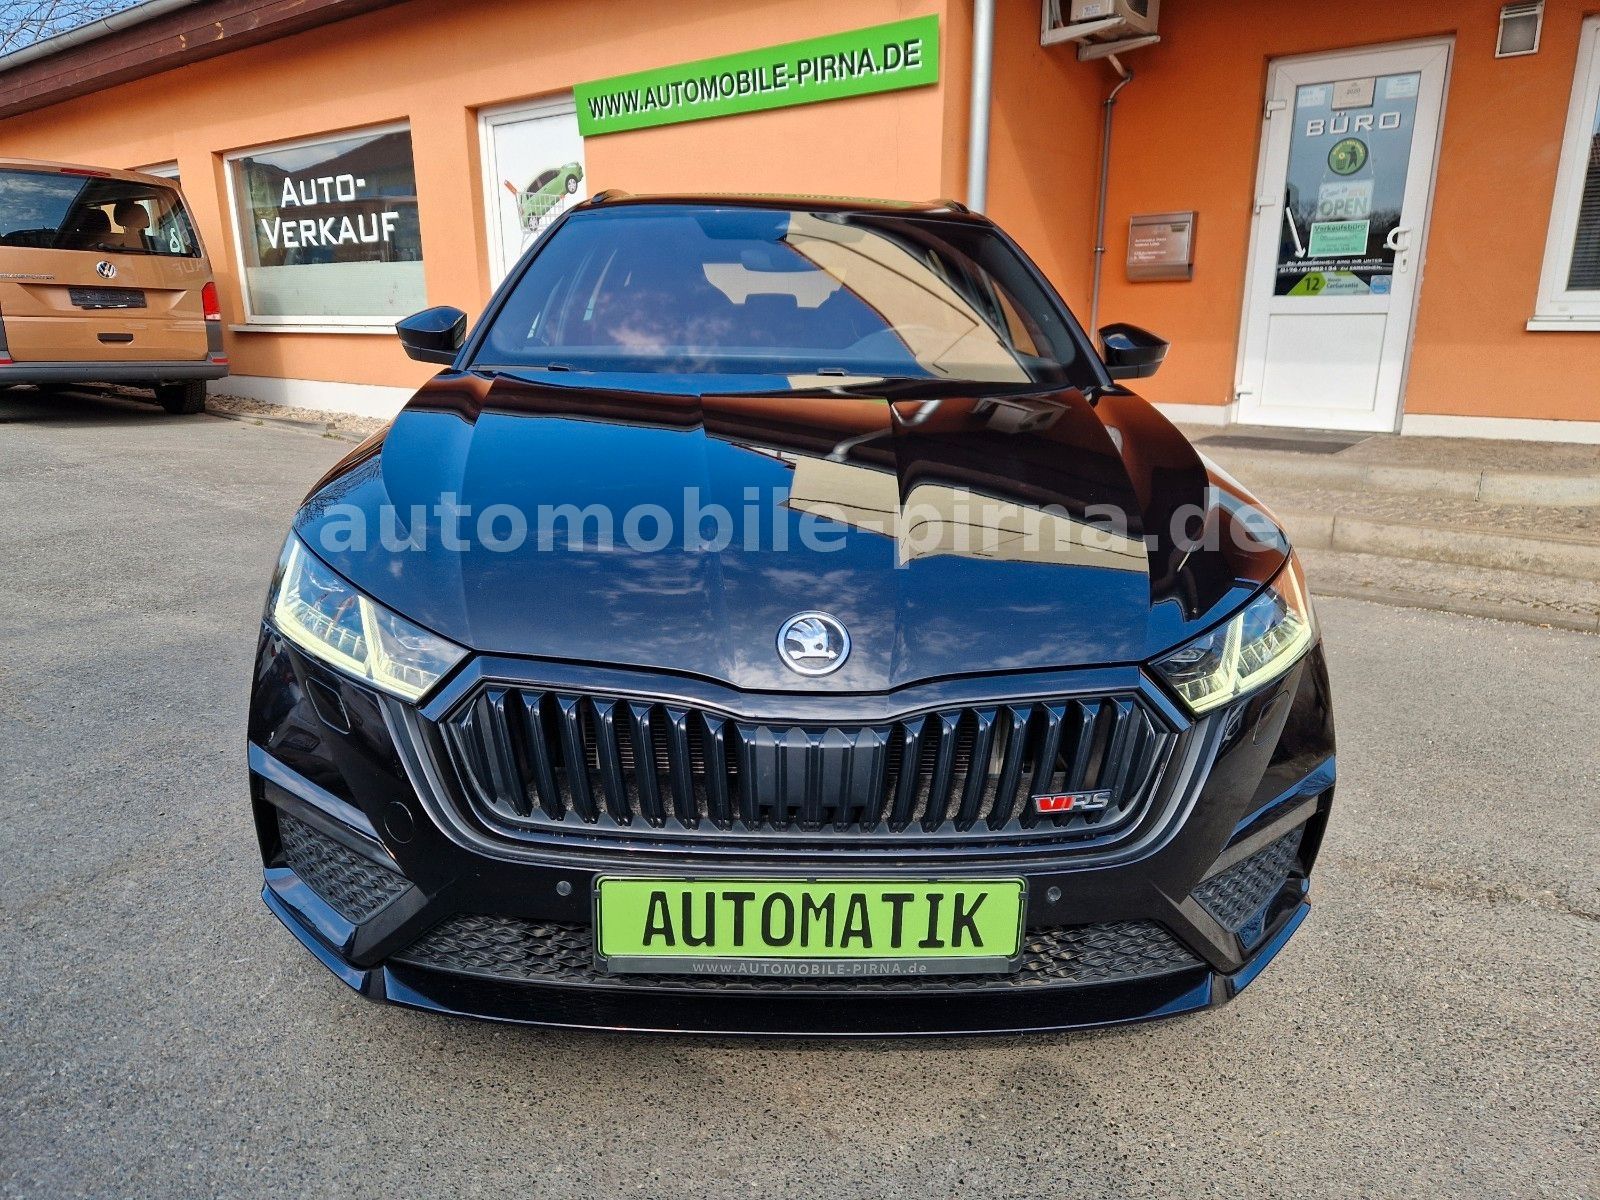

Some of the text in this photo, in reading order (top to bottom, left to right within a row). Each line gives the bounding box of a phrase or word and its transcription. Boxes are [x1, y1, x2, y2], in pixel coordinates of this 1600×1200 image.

[588, 38, 923, 121] WWW.AUTOMOBILE-PIRNA.DE
[1306, 111, 1401, 137] BÜRO
[280, 173, 367, 208] AUTO-
[1321, 198, 1368, 216] OPEN
[261, 211, 400, 249] VERKAUF
[1305, 277, 1320, 291] 12
[642, 890, 989, 949] AUTOMATIK
[692, 961, 928, 976] www.AUTOMOBILE-PIRNA.de
